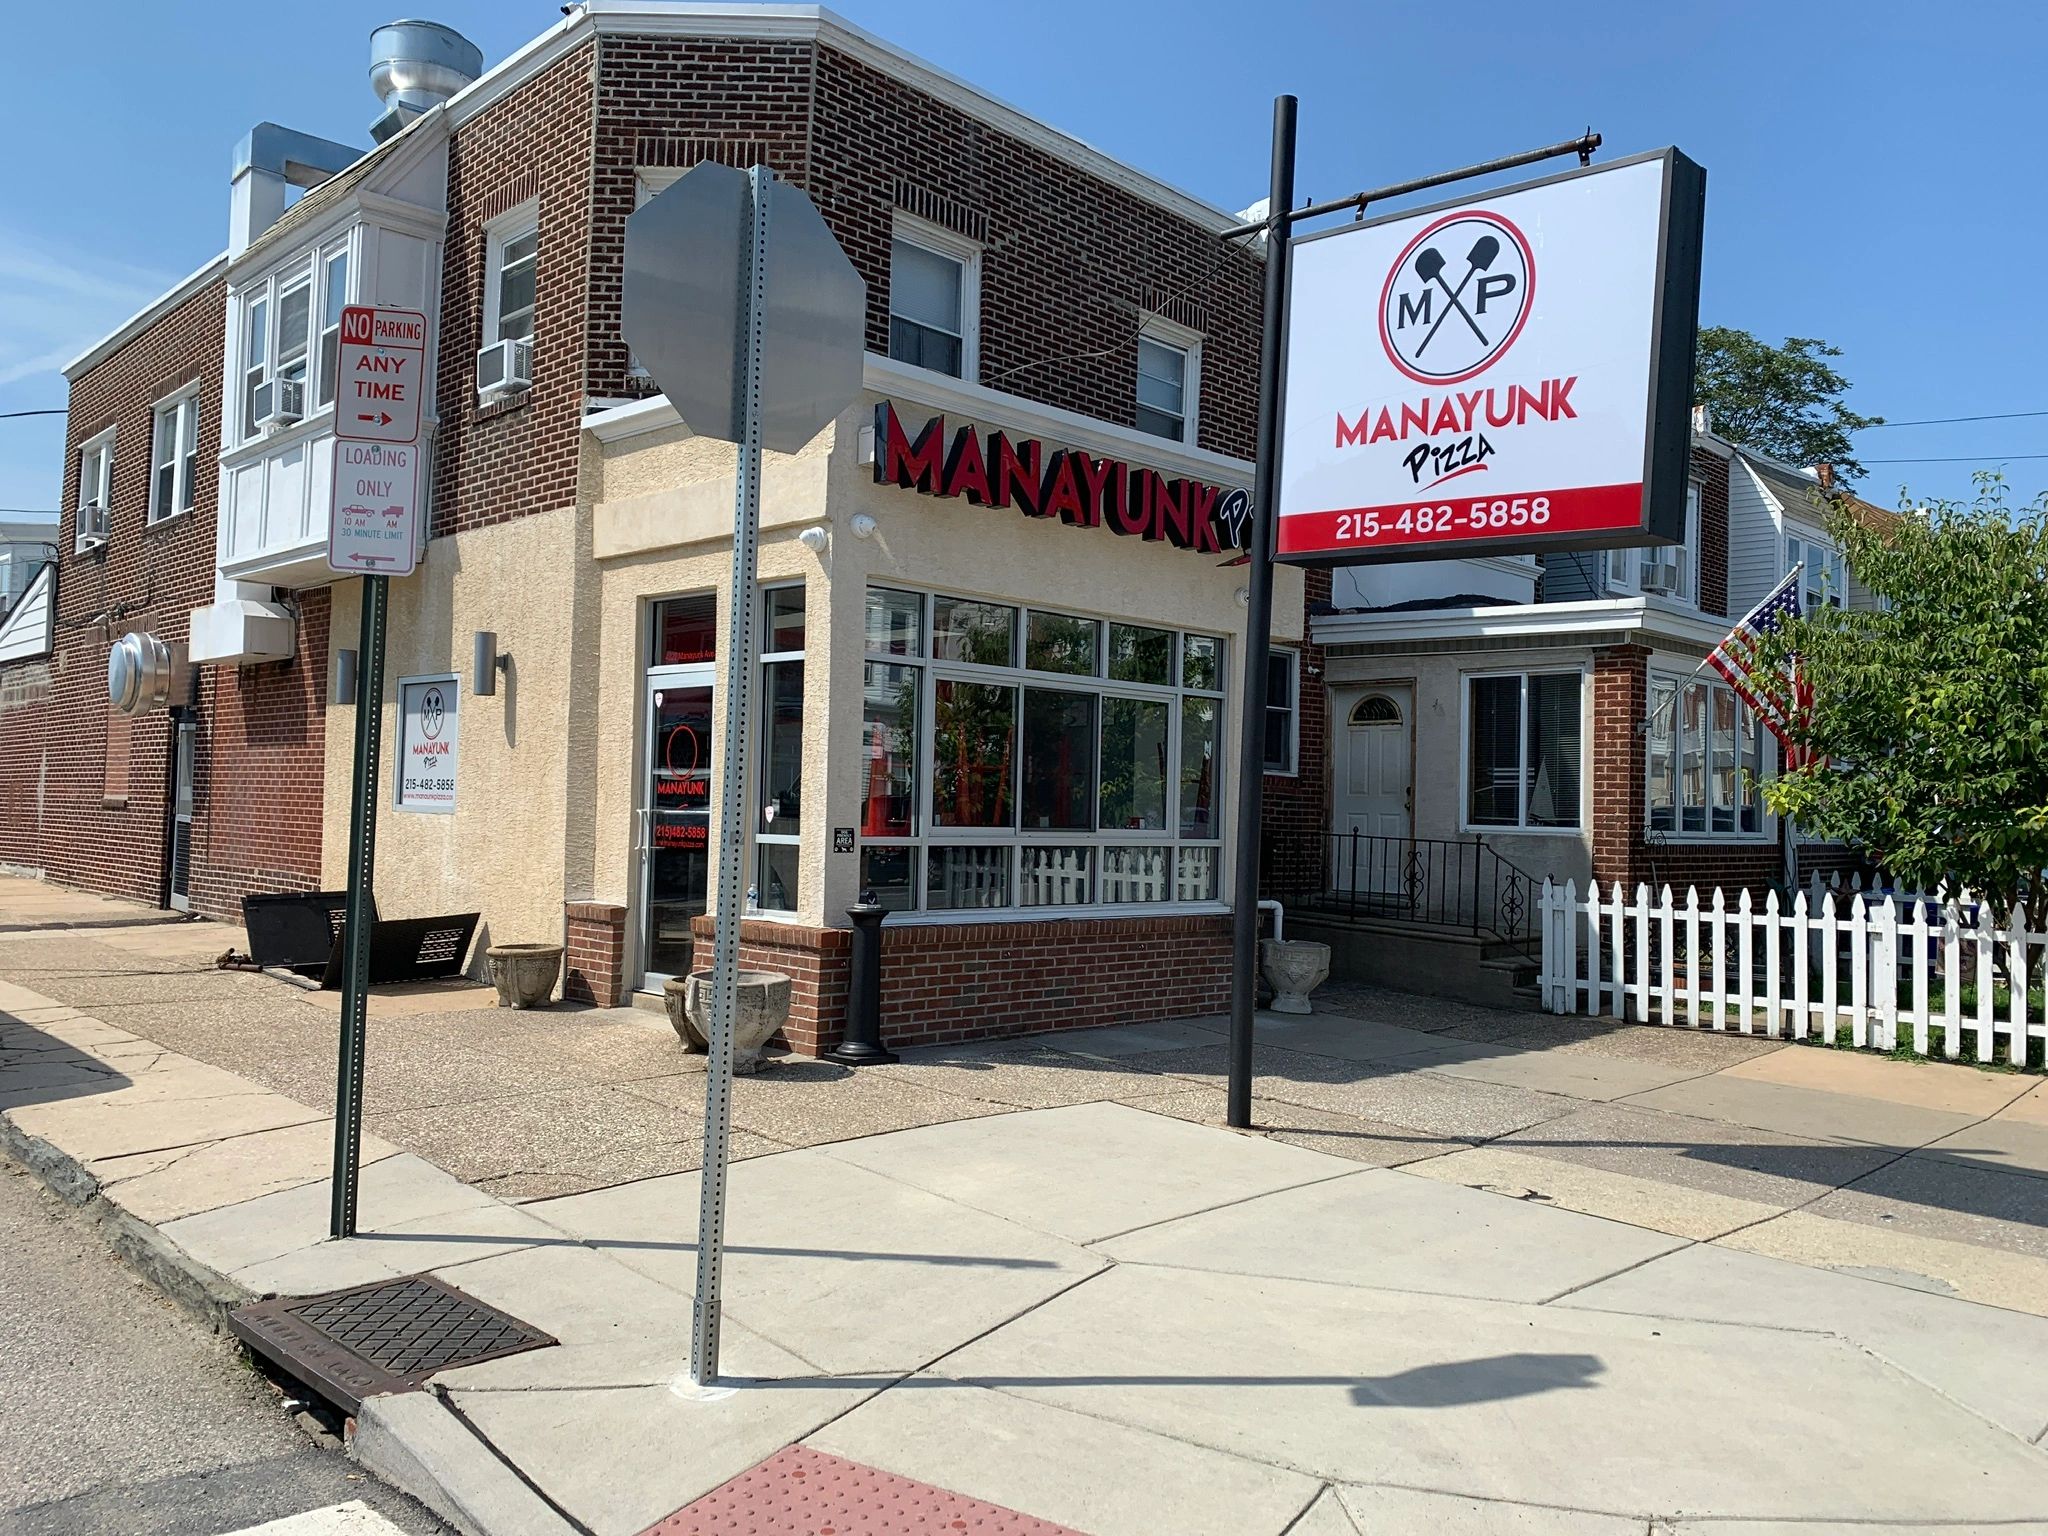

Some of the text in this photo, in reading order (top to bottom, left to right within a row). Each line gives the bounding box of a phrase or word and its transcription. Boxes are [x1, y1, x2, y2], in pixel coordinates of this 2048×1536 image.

[1397, 273, 1517, 330] M P
[344, 312, 421, 340] NO PARKING
[356, 354, 407, 374] ANY
[354, 380, 405, 401] TIME
[1335, 376, 1578, 448] MANAYUNK
[345, 447, 407, 468] LOADING
[874, 400, 1221, 553] MANAYUNK
[356, 479, 393, 498] ONLY
[343, 517, 398, 529] 10 AM AM
[1335, 497, 1550, 540] 215-482-5858
[341, 528, 404, 540] 30 MINUTE LIMIT
[412, 741, 449, 755] MANAYUNK
[405, 778, 454, 791] 215-482-5858
[657, 781, 705, 795] MANAYUNK
[836, 837, 853, 845] AREA
